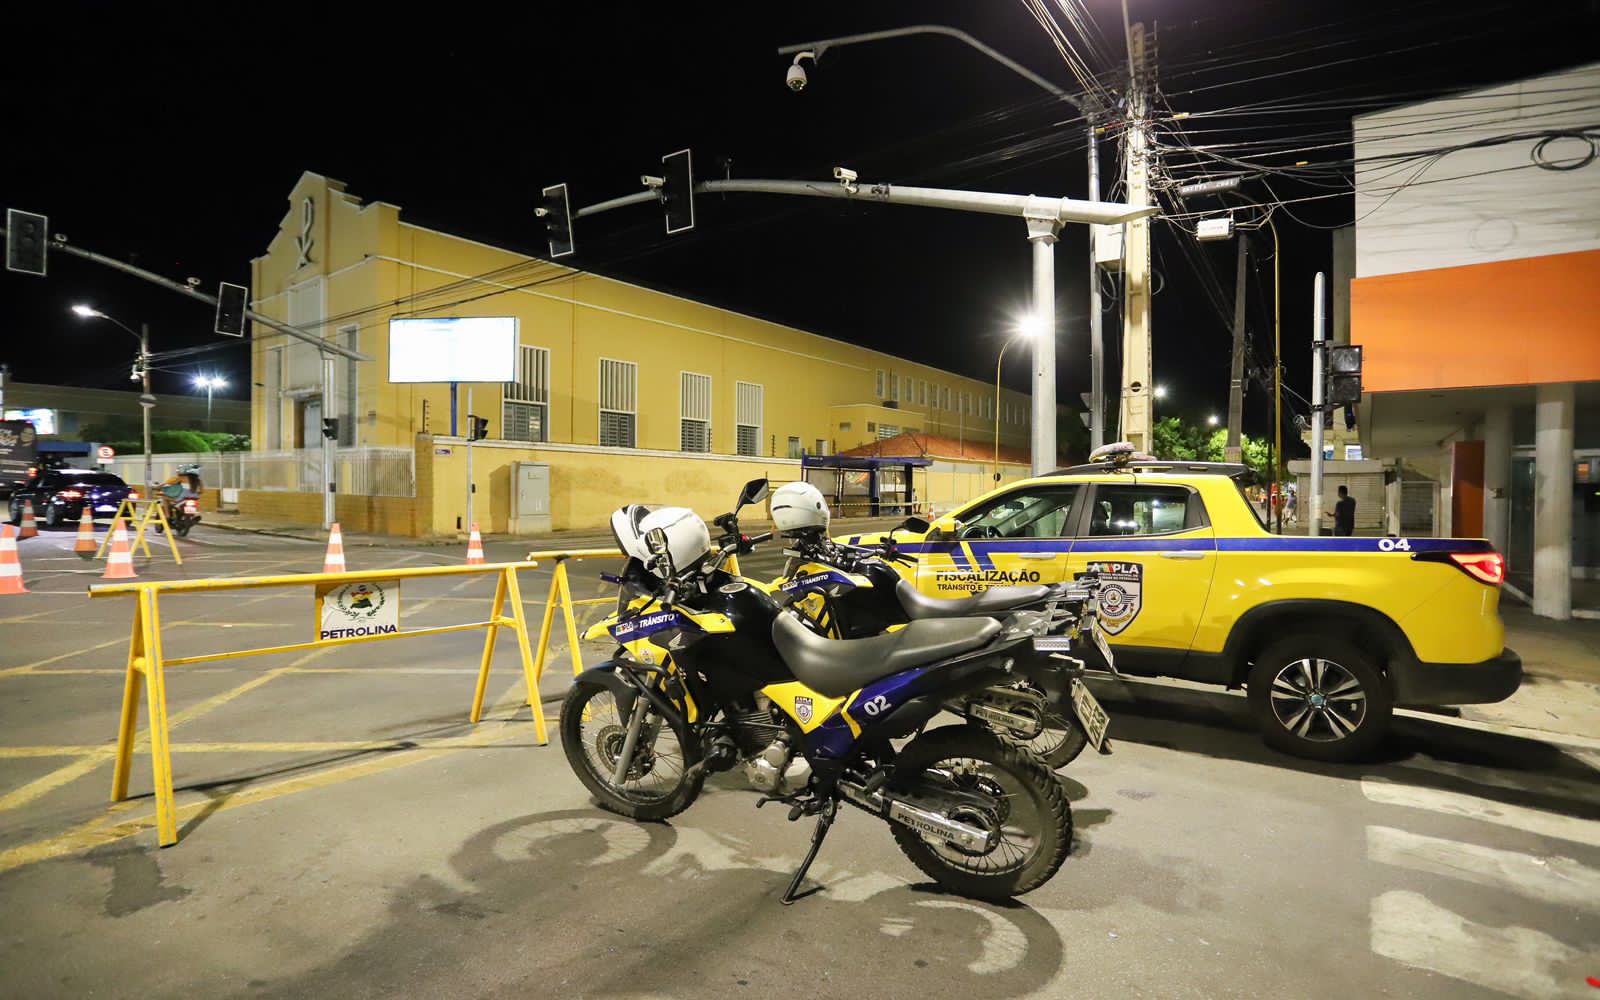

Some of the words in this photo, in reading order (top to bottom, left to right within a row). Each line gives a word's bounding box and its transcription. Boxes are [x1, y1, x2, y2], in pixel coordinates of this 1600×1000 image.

[1378, 538, 1411, 551] 04
[936, 569, 1040, 584] FISCALIZAÇÃO
[320, 624, 397, 640] PETROLINA
[863, 695, 892, 716] 02
[897, 812, 955, 840] PETROLINA
